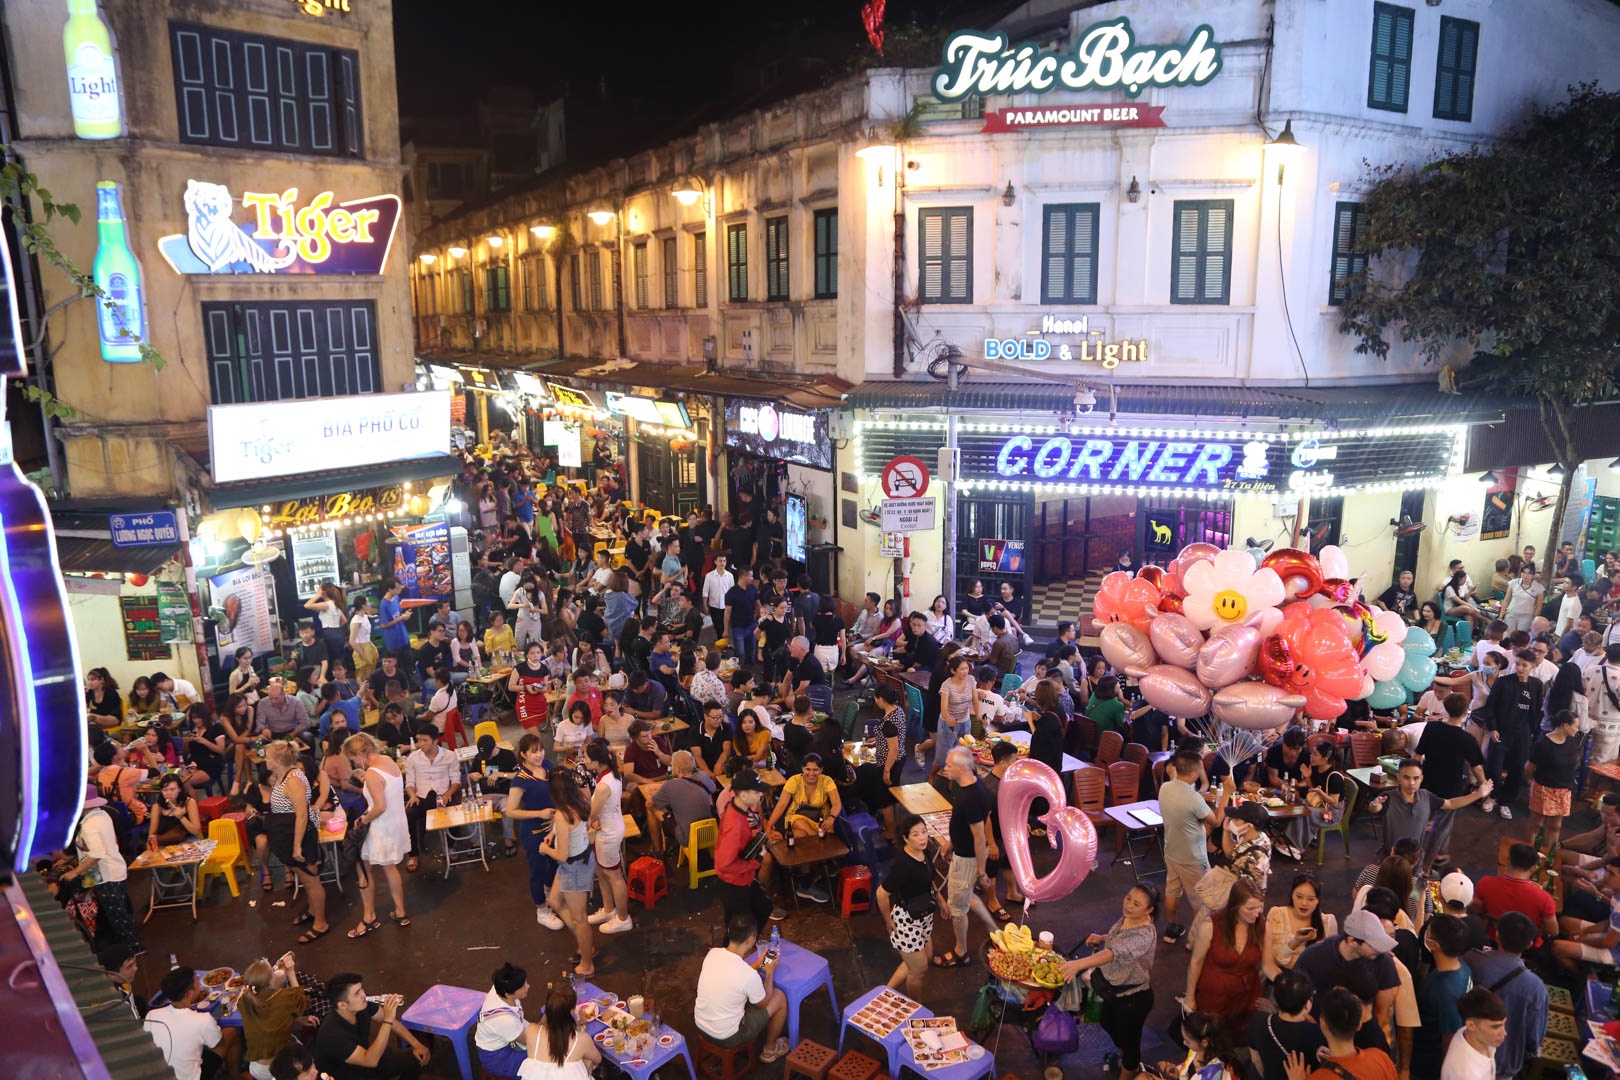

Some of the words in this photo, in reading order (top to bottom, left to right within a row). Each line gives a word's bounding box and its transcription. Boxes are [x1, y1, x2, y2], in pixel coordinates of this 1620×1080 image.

[936, 34, 1058, 98] Trúc
[1061, 22, 1218, 93] Bạch
[71, 76, 117, 99] Light
[1006, 109, 1100, 125] PARAMOUNT
[1103, 107, 1139, 121] BEER
[984, 339, 1051, 360] BOLD
[1059, 344, 1073, 360] &
[1080, 339, 1148, 369] Light
[322, 419, 353, 438] BIA
[997, 435, 1232, 484] CORNER
[326, 493, 374, 517] Béo
